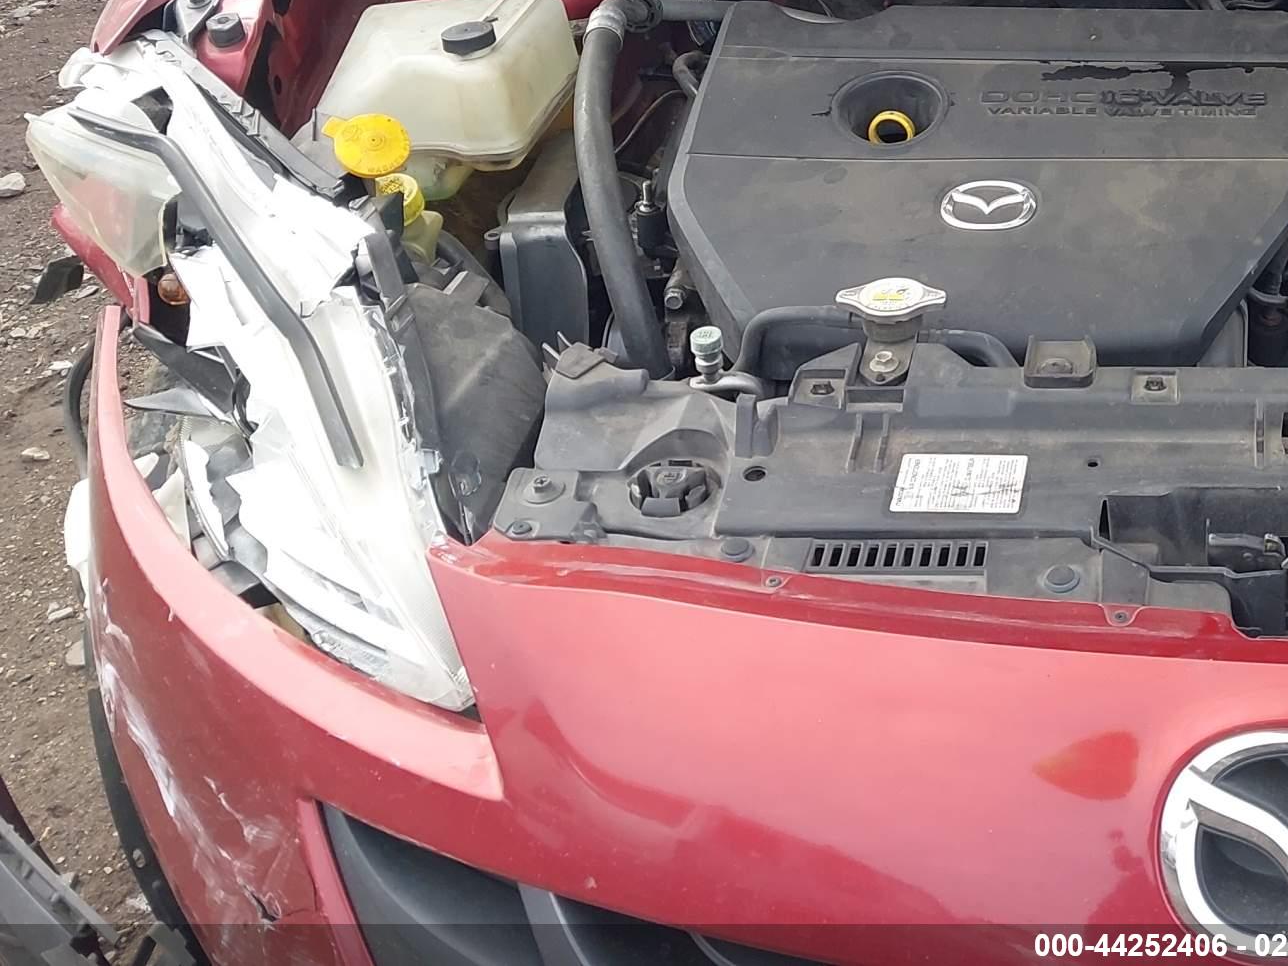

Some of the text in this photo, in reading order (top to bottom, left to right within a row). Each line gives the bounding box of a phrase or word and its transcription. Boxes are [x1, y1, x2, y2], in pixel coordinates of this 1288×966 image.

[981, 90, 1097, 103] DOHC
[987, 106, 1258, 117] VARIABLE VALVE TIMING
